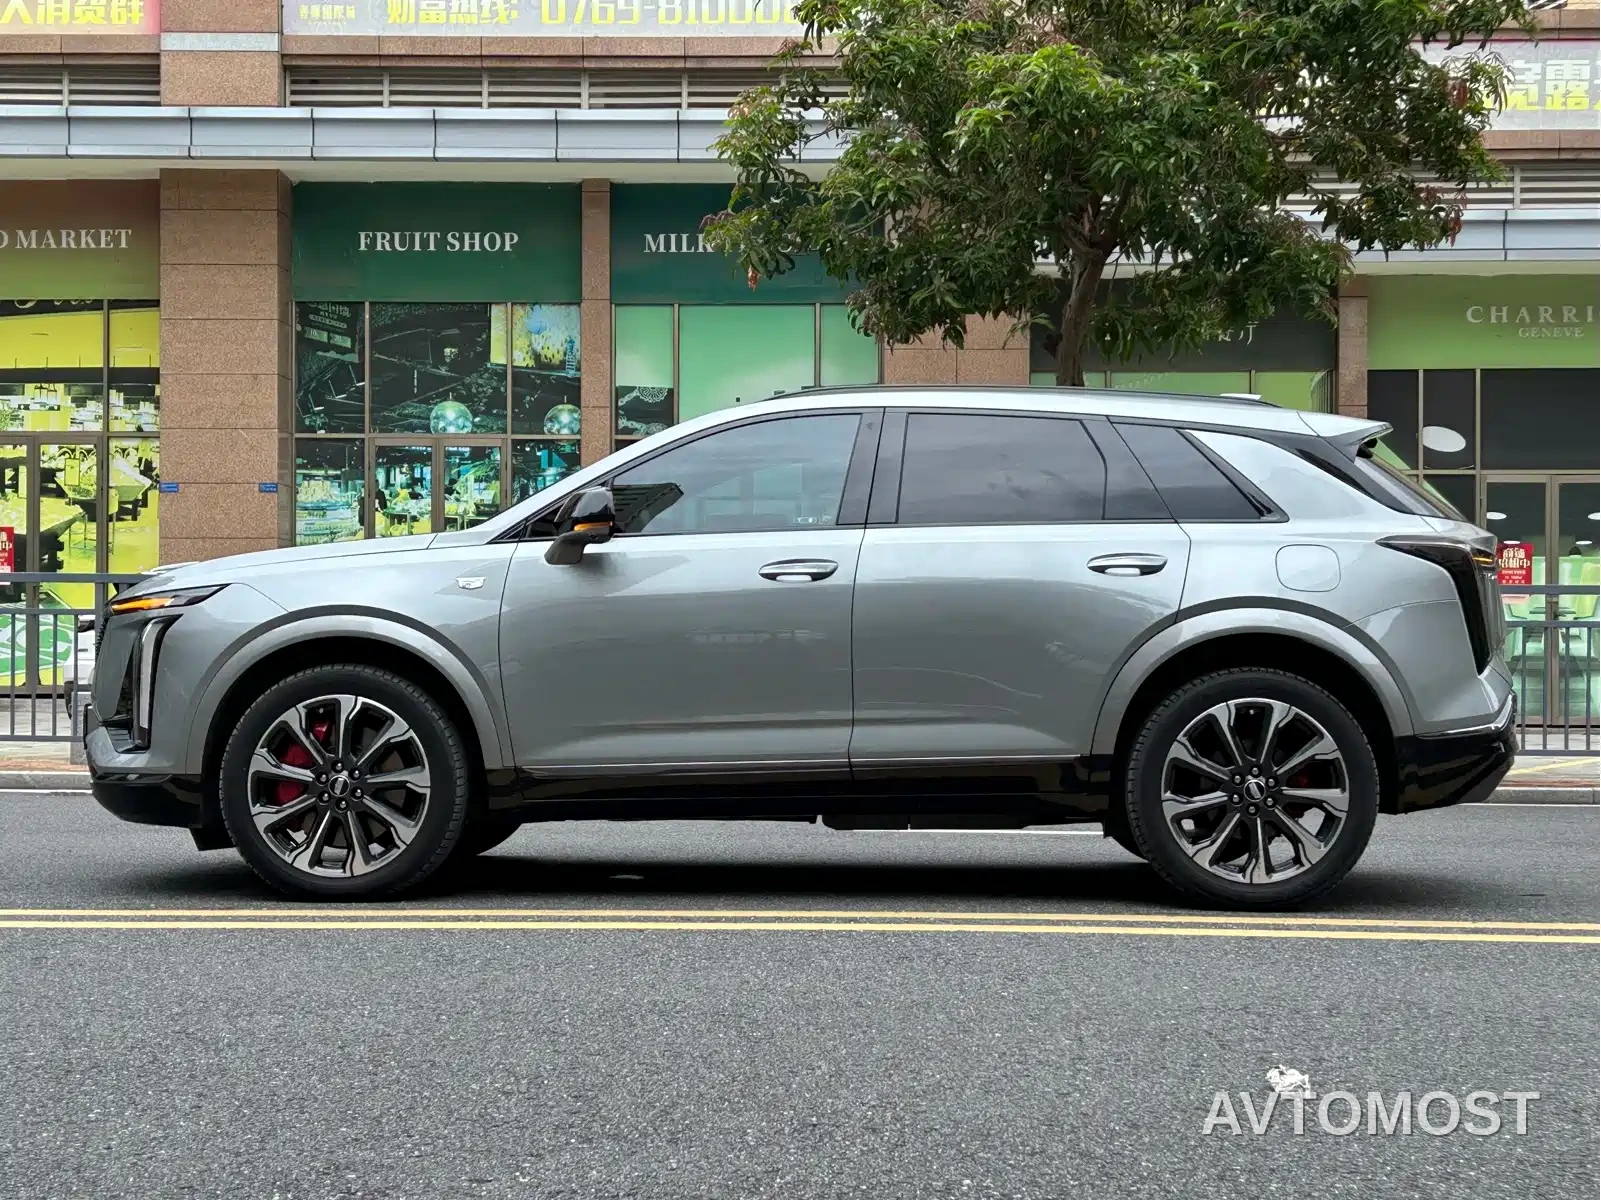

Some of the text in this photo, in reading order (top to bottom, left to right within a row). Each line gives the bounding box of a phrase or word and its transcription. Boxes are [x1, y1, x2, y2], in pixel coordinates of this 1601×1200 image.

[15, 228, 132, 249] MARKET
[357, 231, 519, 252] FRUIT SHOP
[1465, 304, 1594, 324] CHARRI
[1517, 326, 1585, 338] GENEVE
